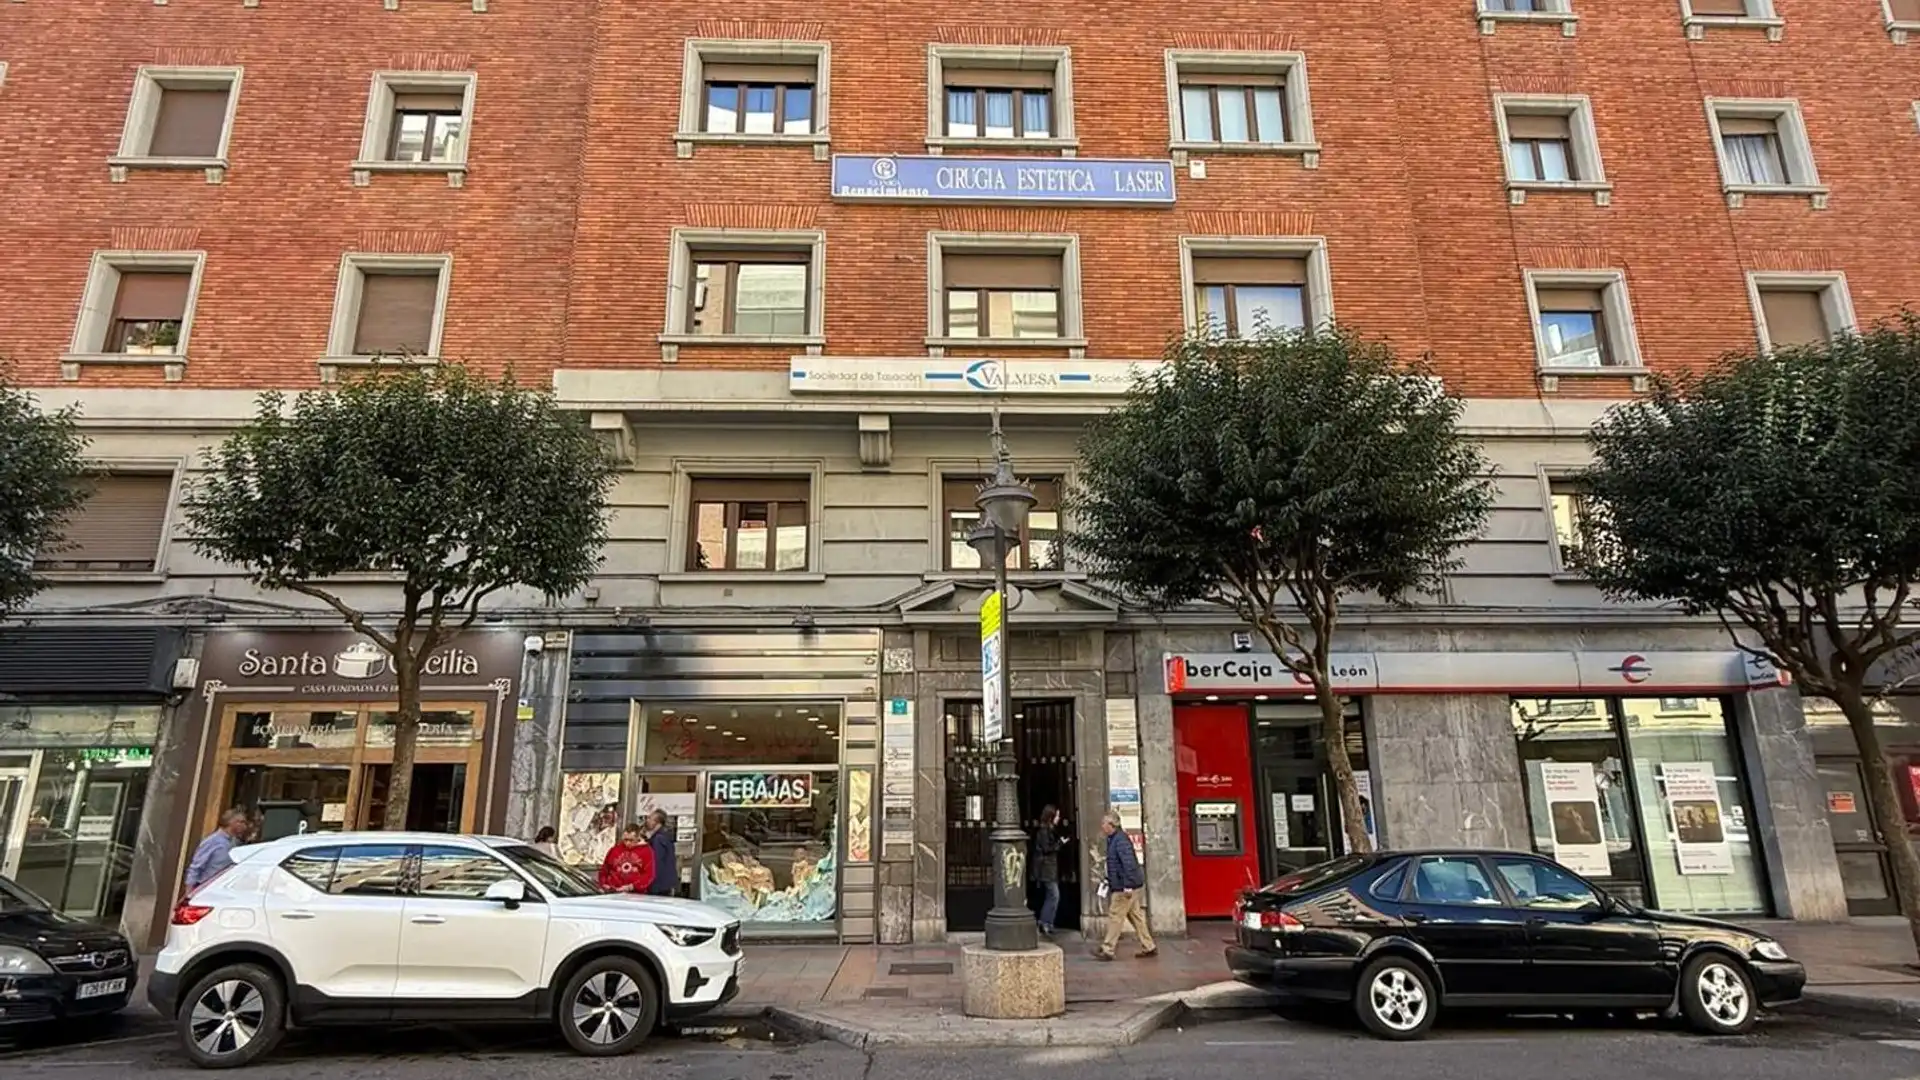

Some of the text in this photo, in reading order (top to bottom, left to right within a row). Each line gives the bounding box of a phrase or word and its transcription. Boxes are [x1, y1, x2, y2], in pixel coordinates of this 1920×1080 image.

[841, 185, 929, 196] Renacimiento
[1114, 170, 1166, 192] LASER
[808, 371, 922, 382] Sociedad de Tasación
[981, 366, 1058, 386] VALMESA
[239, 648, 326, 676] Santa
[1186, 659, 1368, 682] berCaja León
[301, 684, 326, 694] CASA
[326, 684, 375, 693] FUNDADA
[375, 684, 389, 693] EN
[714, 779, 804, 800] REBAJAS
